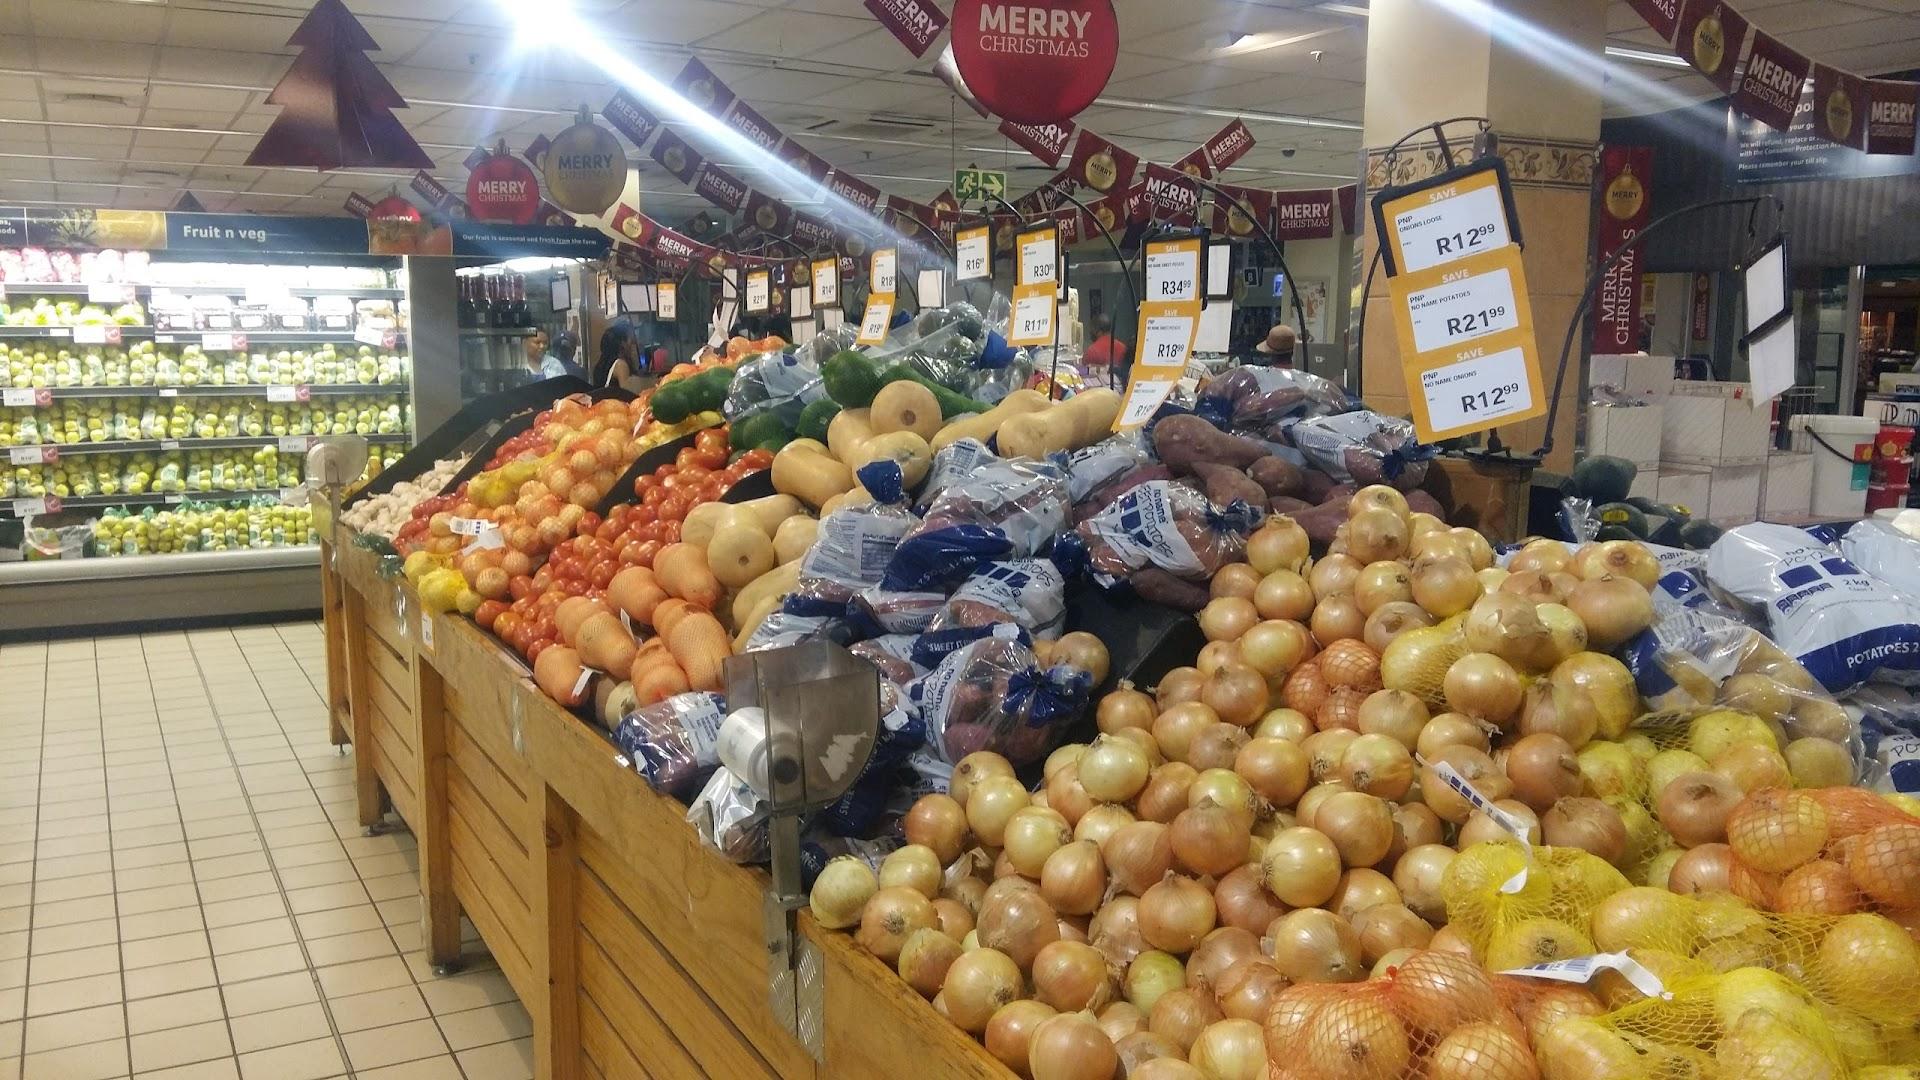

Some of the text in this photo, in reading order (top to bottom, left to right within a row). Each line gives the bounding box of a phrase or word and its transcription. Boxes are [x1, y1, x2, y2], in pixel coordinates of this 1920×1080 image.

[879, 0, 929, 45] HRISTMAS
[895, 0, 940, 36] ERRY
[979, 4, 1092, 39] MERRY
[979, 35, 1089, 58] CHRISTMAS
[1748, 53, 1803, 98] MERRY
[1743, 77, 1795, 114] CHRISTMAS
[613, 97, 653, 133] MERRY
[1871, 101, 1916, 124] MERRY
[732, 111, 775, 148] MERRY
[1211, 125, 1246, 159] MERRY
[1215, 135, 1251, 165] CHRISTMAS
[1739, 149, 1754, 158] with
[1796, 143, 1830, 152] Protection
[1750, 139, 1761, 148] will
[558, 153, 613, 170] MERRY
[1090, 161, 1113, 177] MERRY
[1739, 161, 1759, 171] Please
[1759, 160, 1789, 169] remember
[416, 174, 444, 199] MERRY
[478, 180, 528, 195] MERRY
[703, 170, 743, 202] MERRY
[832, 180, 876, 208] MERRY
[1146, 176, 1200, 206] MERRY
[1429, 187, 1457, 202] SAVE
[1612, 191, 1638, 200] MERRY
[478, 193, 528, 204] CHRISTMAS
[1281, 203, 1331, 220] MERRY
[1397, 215, 1413, 226] PNP
[795, 219, 834, 240] MERRY
[1281, 217, 1330, 230] CHRISTMAS
[1399, 214, 1443, 233] ONIONS LOOSE
[183, 225, 267, 243] Fruit n veg
[462, 234, 476, 242] Our
[476, 234, 490, 242] fruit
[539, 236, 555, 244] fresh
[582, 238, 597, 246] farm
[658, 234, 694, 257] MERRY
[1166, 245, 1179, 254] SAVE
[1442, 269, 1470, 284] SAVE
[1616, 228, 1636, 345] CHRISTMS
[1409, 294, 1425, 304] PNP
[1410, 290, 1471, 312] NO NAME POTATOES
[1164, 309, 1178, 317] SAVE
[1456, 347, 1485, 363] SAVE
[1423, 371, 1438, 381] PNP
[1424, 369, 1477, 389] NO NAME ONIONS
[1153, 489, 1169, 525] no name
[927, 640, 955, 652] SWEET
[1846, 641, 1910, 669] POTATOES
